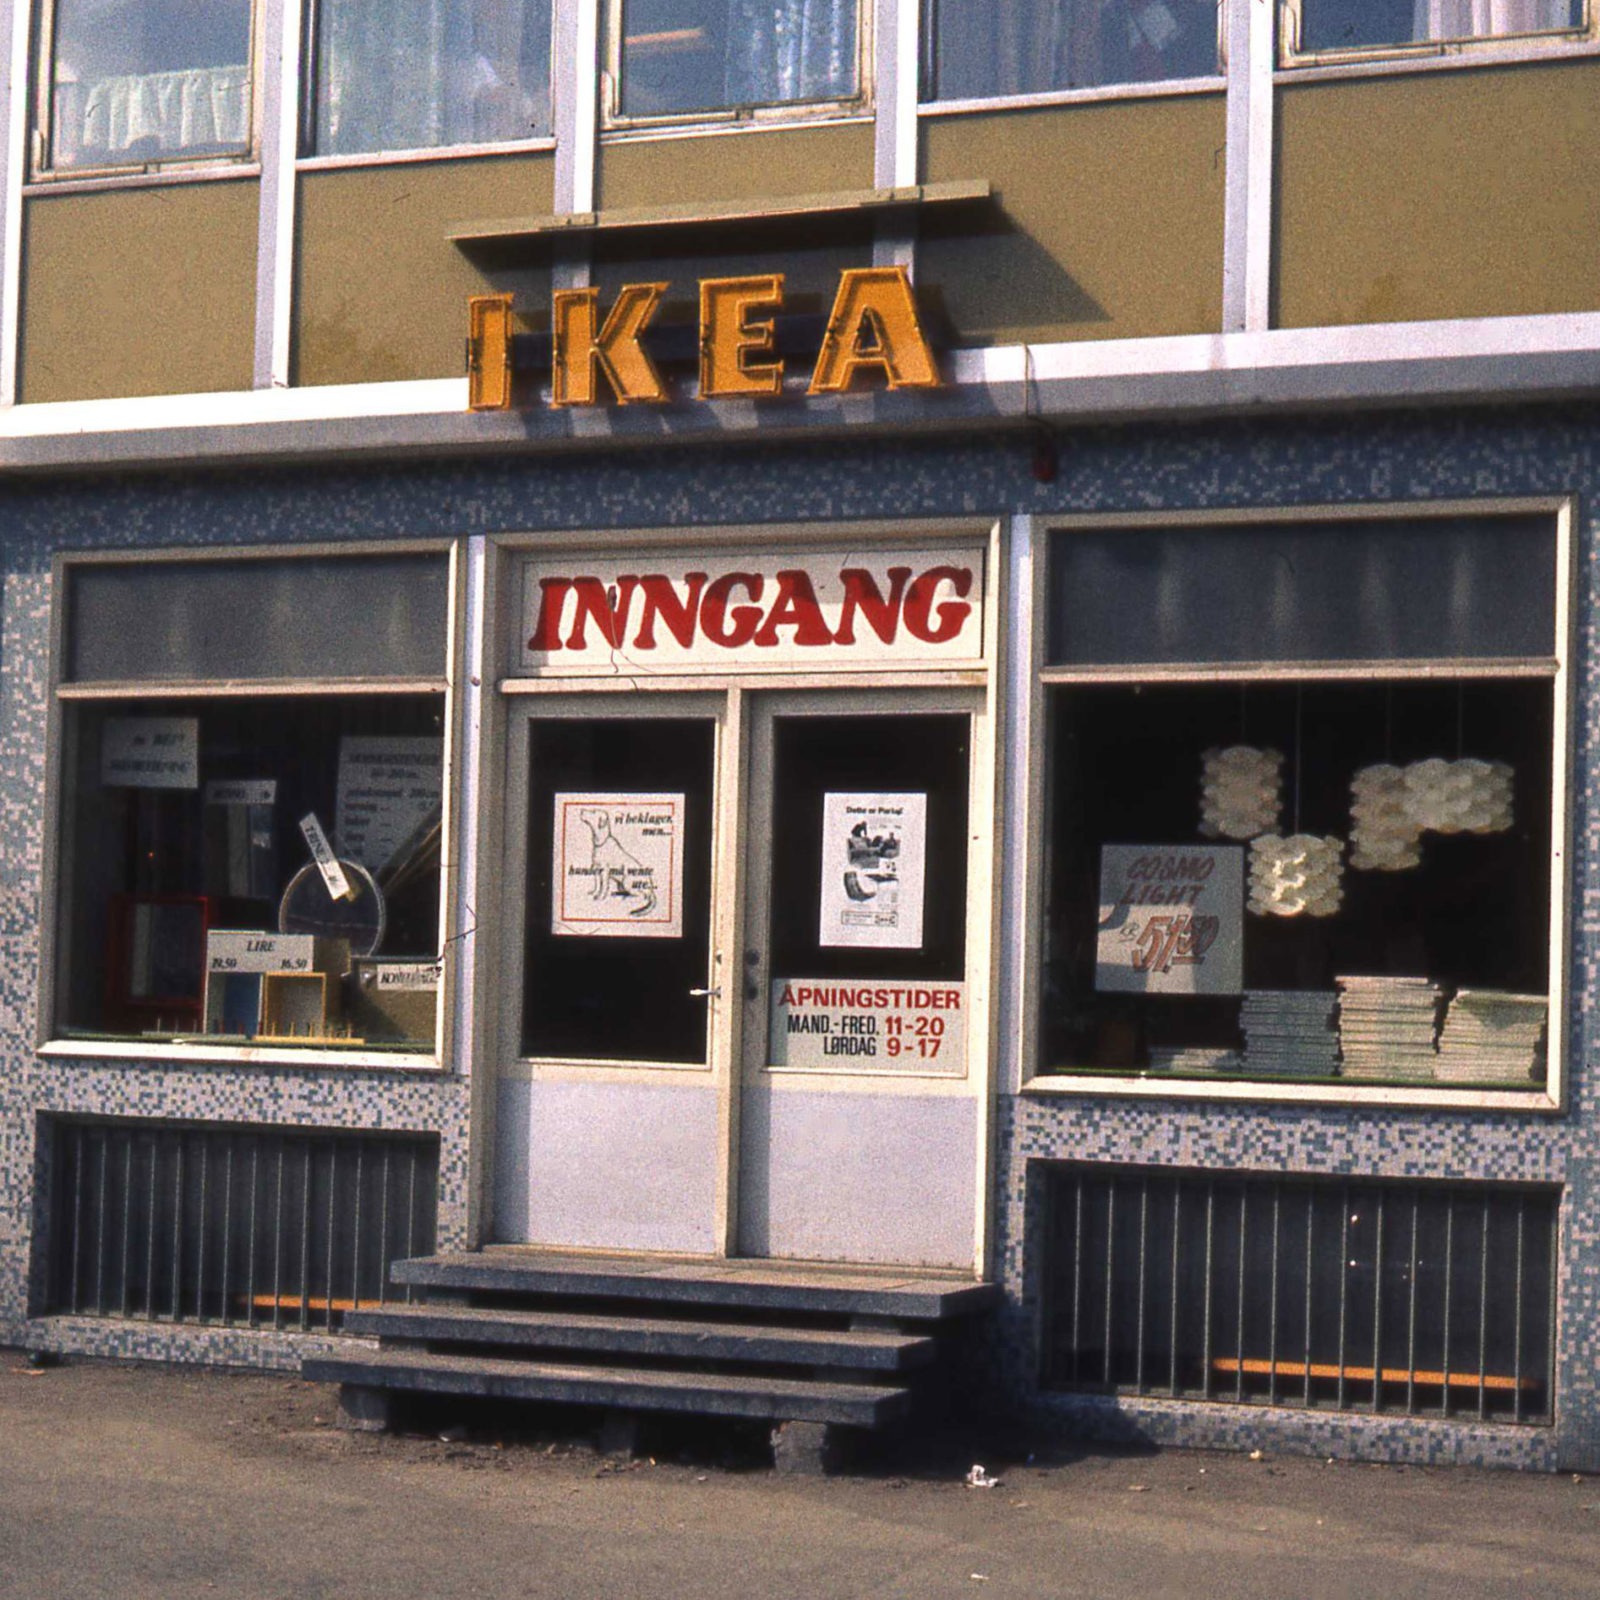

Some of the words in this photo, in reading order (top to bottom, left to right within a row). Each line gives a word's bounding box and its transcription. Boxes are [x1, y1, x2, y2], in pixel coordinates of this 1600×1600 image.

[468, 265, 943, 413] IKEA
[528, 565, 973, 651] INNGANG
[1126, 856, 1216, 881] COSMO
[1120, 883, 1206, 907] LIGHT
[246, 941, 276, 952] LIRE
[778, 984, 961, 1010] ÅPNINGSTIDER
[885, 1016, 946, 1037] 11-20
[823, 1036, 877, 1056] LØRDAG
